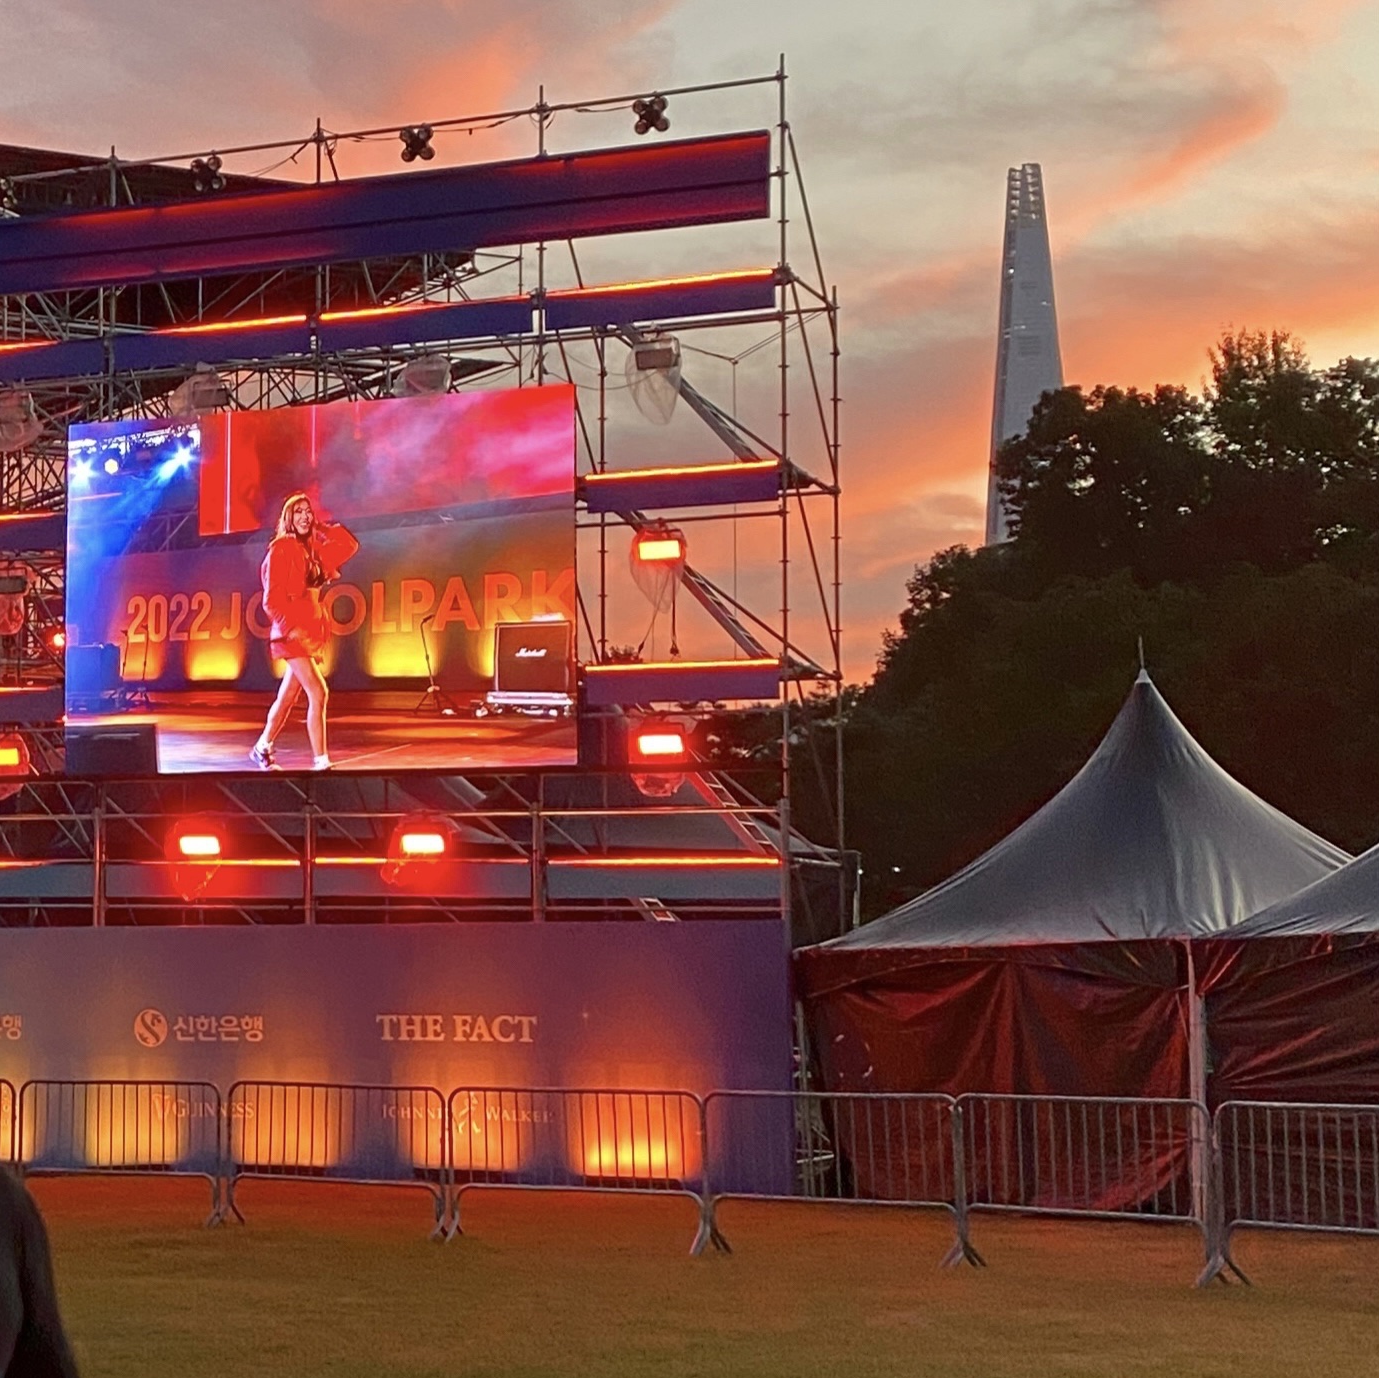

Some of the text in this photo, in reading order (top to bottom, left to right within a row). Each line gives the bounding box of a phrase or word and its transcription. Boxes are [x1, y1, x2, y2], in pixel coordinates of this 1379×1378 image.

[127, 591, 212, 643] 2022
[322, 567, 575, 637] OLPARK
[173, 1015, 264, 1042] 신한은행
[376, 1014, 538, 1043] THE FACT
